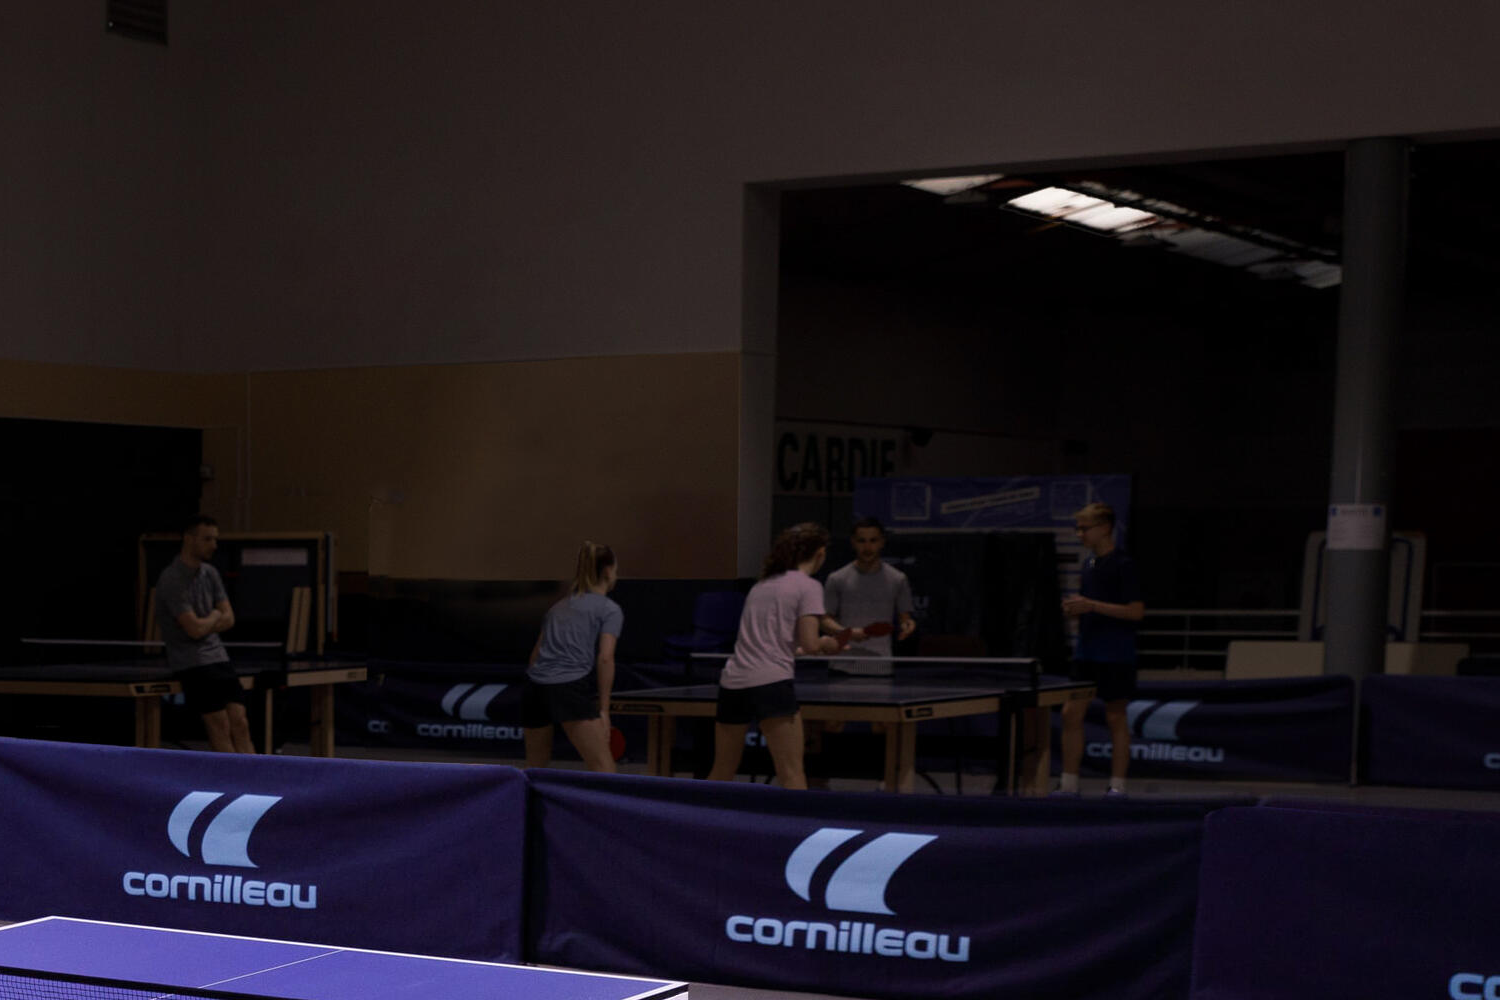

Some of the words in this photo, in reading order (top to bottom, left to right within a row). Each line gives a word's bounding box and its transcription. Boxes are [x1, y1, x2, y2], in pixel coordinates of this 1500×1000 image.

[417, 723, 524, 739] cornilleau
[1086, 742, 1225, 762] conilleau
[123, 871, 317, 909] cornilleau
[726, 915, 970, 962] cornilleau
